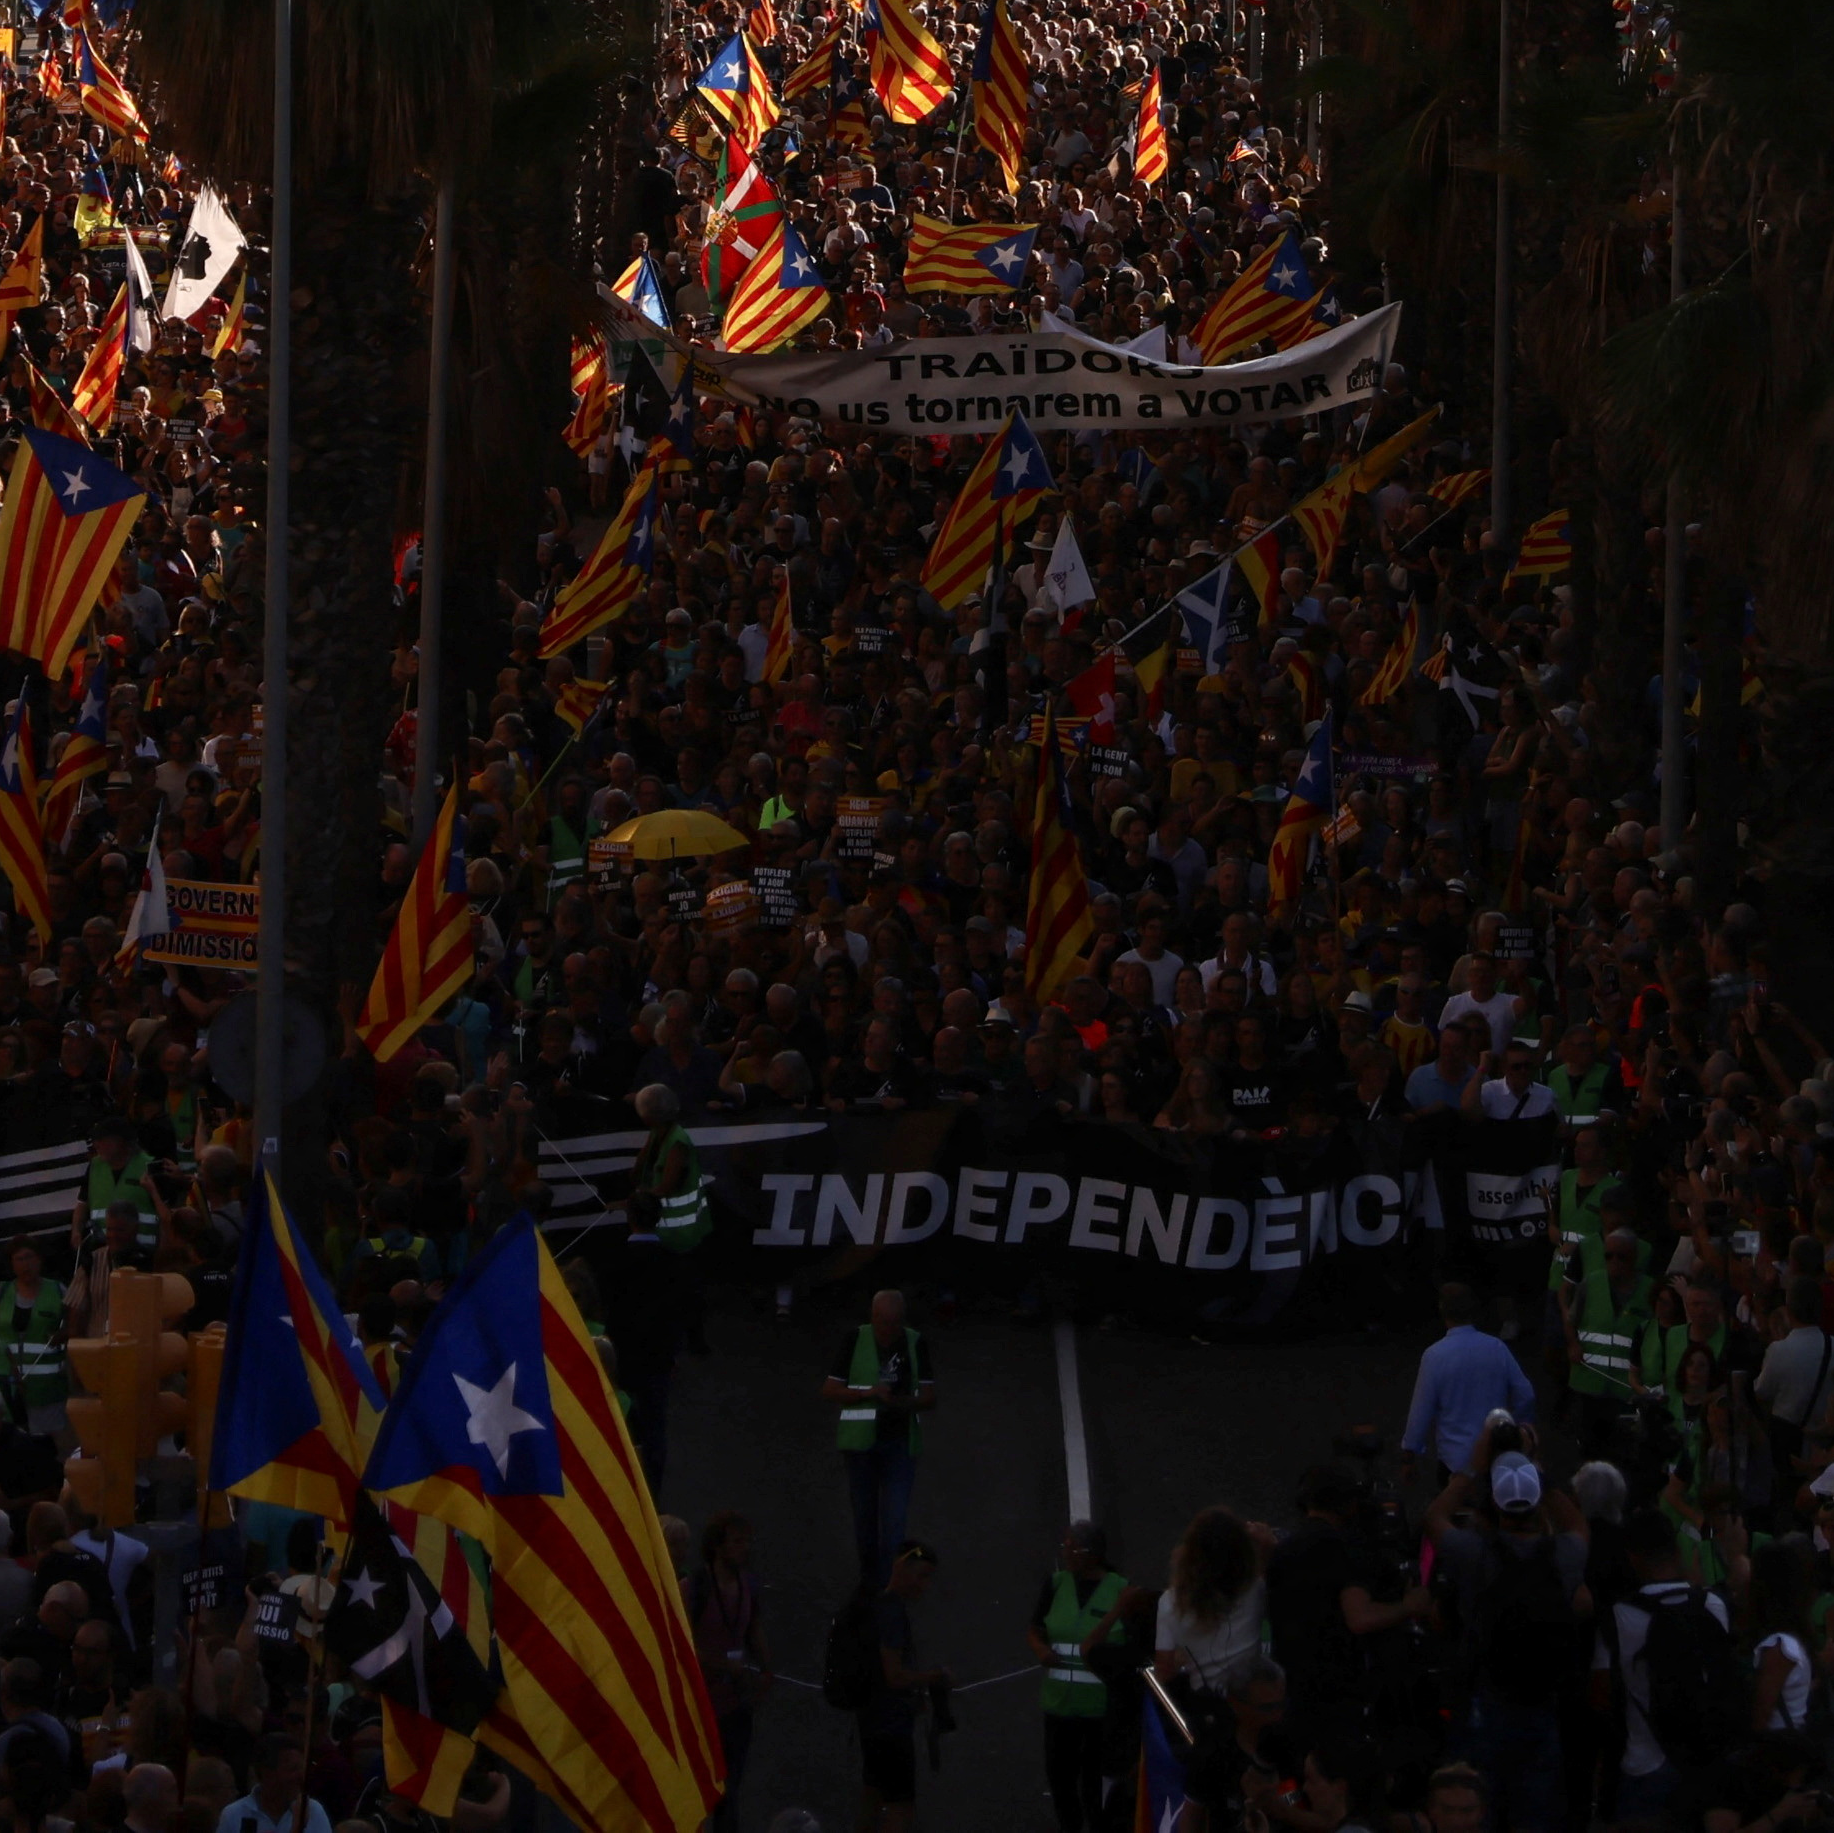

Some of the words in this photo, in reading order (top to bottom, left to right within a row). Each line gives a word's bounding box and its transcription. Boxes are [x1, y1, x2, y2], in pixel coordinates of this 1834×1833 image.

[757, 394, 821, 417] NO
[839, 402, 889, 425] us
[905, 392, 1121, 424] tornarem
[1137, 394, 1162, 418] a
[1175, 373, 1332, 418] VOTAR
[1091, 746, 1103, 757] LA
[1104, 748, 1128, 761] GENT
[1102, 764, 1123, 777] SOM
[753, 867, 792, 879] BOTIFLERS
[166, 885, 254, 916] GOVERN
[151, 932, 257, 962] DIMISSIÓ
